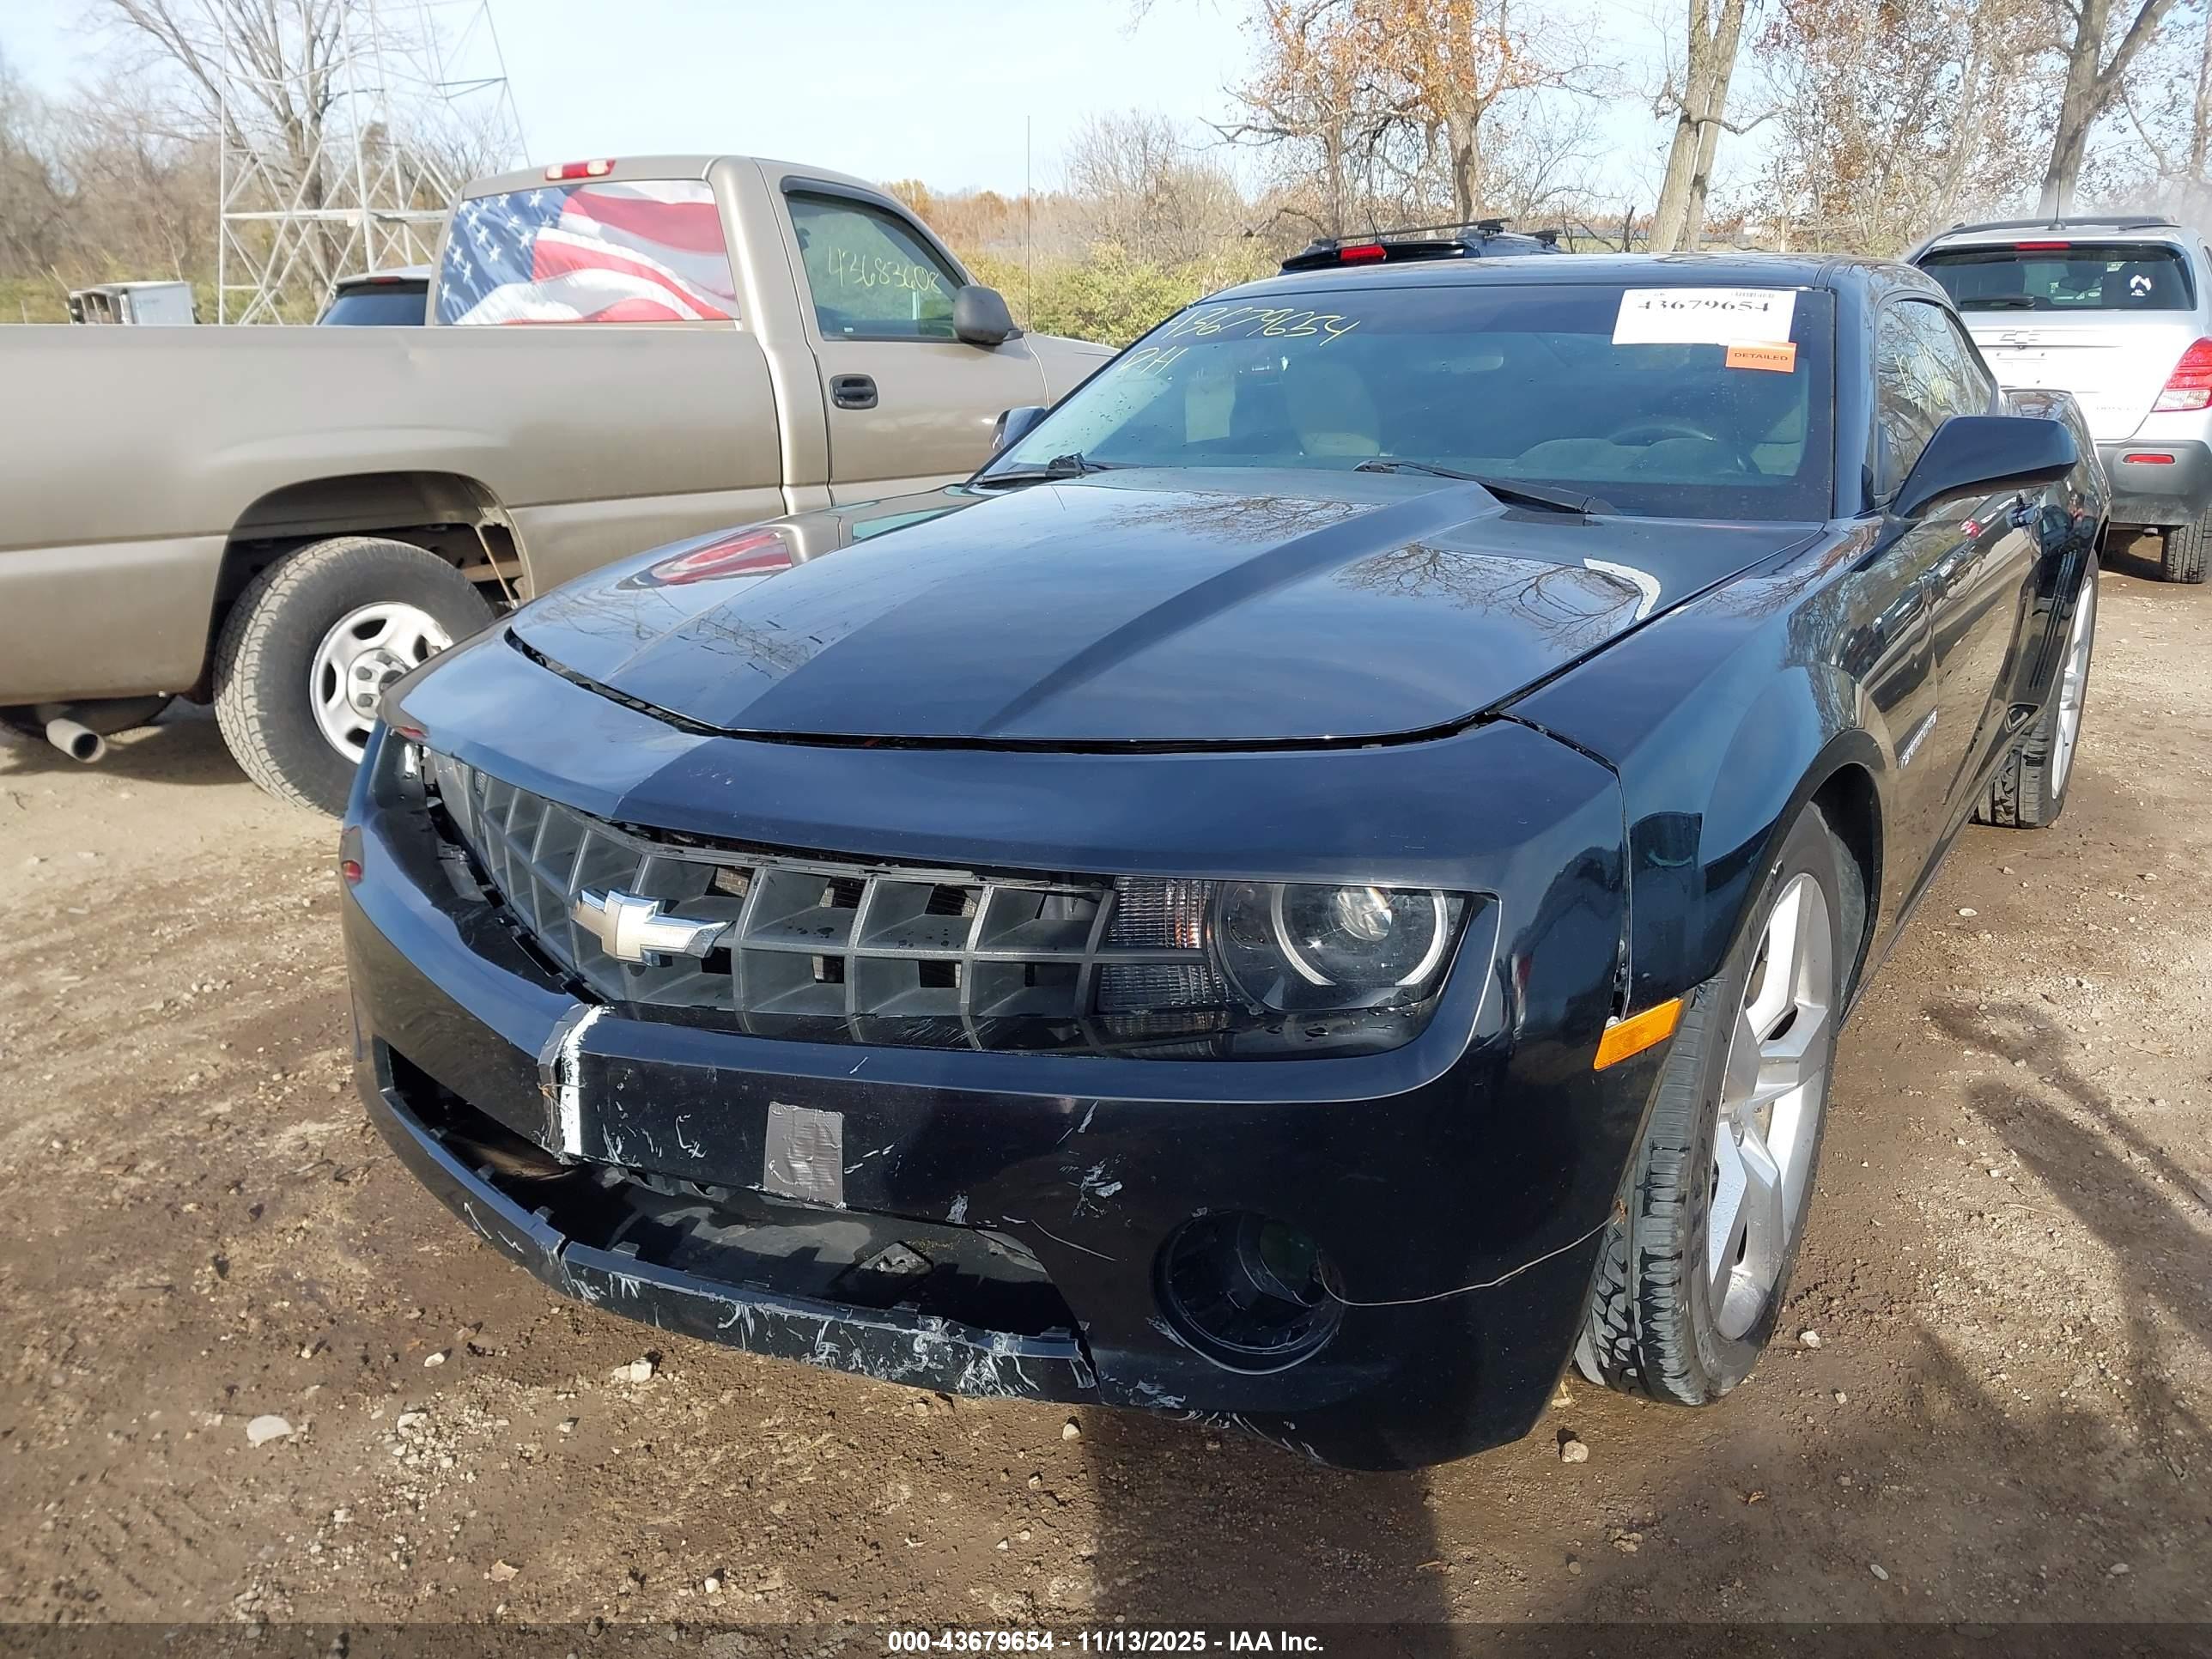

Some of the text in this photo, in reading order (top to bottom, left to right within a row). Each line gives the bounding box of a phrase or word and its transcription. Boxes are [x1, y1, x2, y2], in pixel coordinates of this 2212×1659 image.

[829, 247, 941, 294] 43683608
[1638, 300, 1769, 312] 43679654
[1161, 307, 1360, 346] 43679654
[1734, 352, 1788, 361] DETAILED
